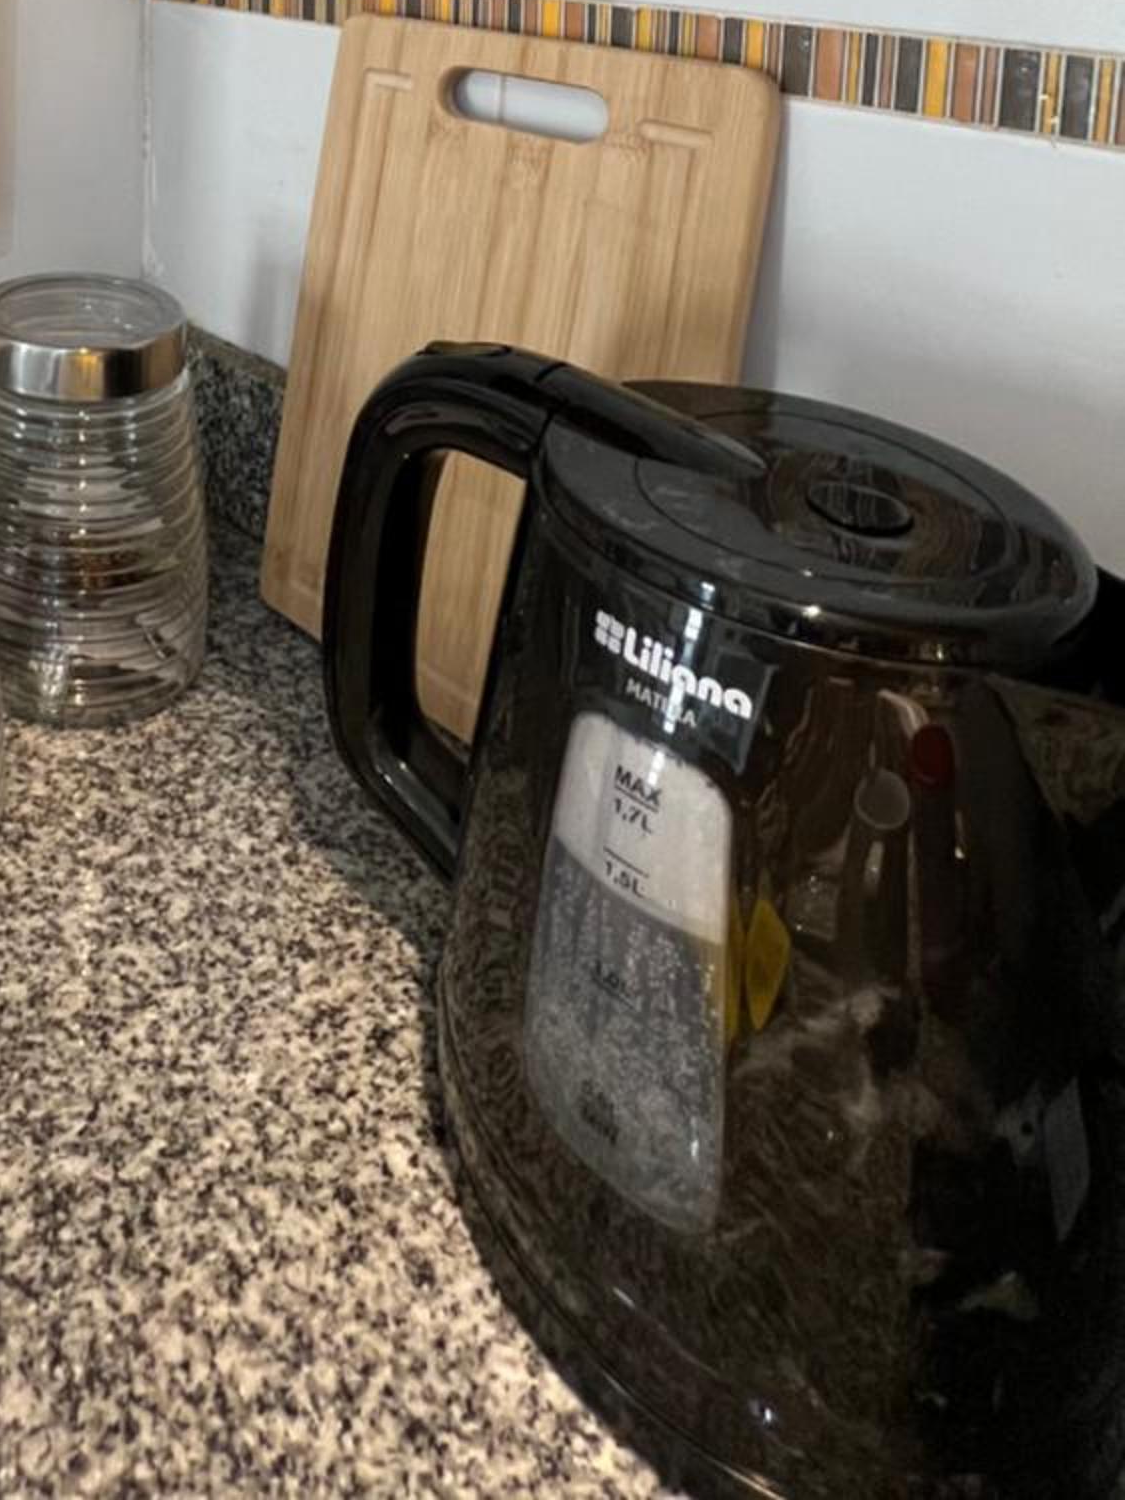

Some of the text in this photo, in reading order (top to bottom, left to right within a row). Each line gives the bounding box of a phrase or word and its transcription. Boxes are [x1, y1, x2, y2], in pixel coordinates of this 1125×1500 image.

[623, 626, 754, 721] Liliana
[614, 764, 664, 808] MAX
[612, 797, 654, 835] 1.7L
